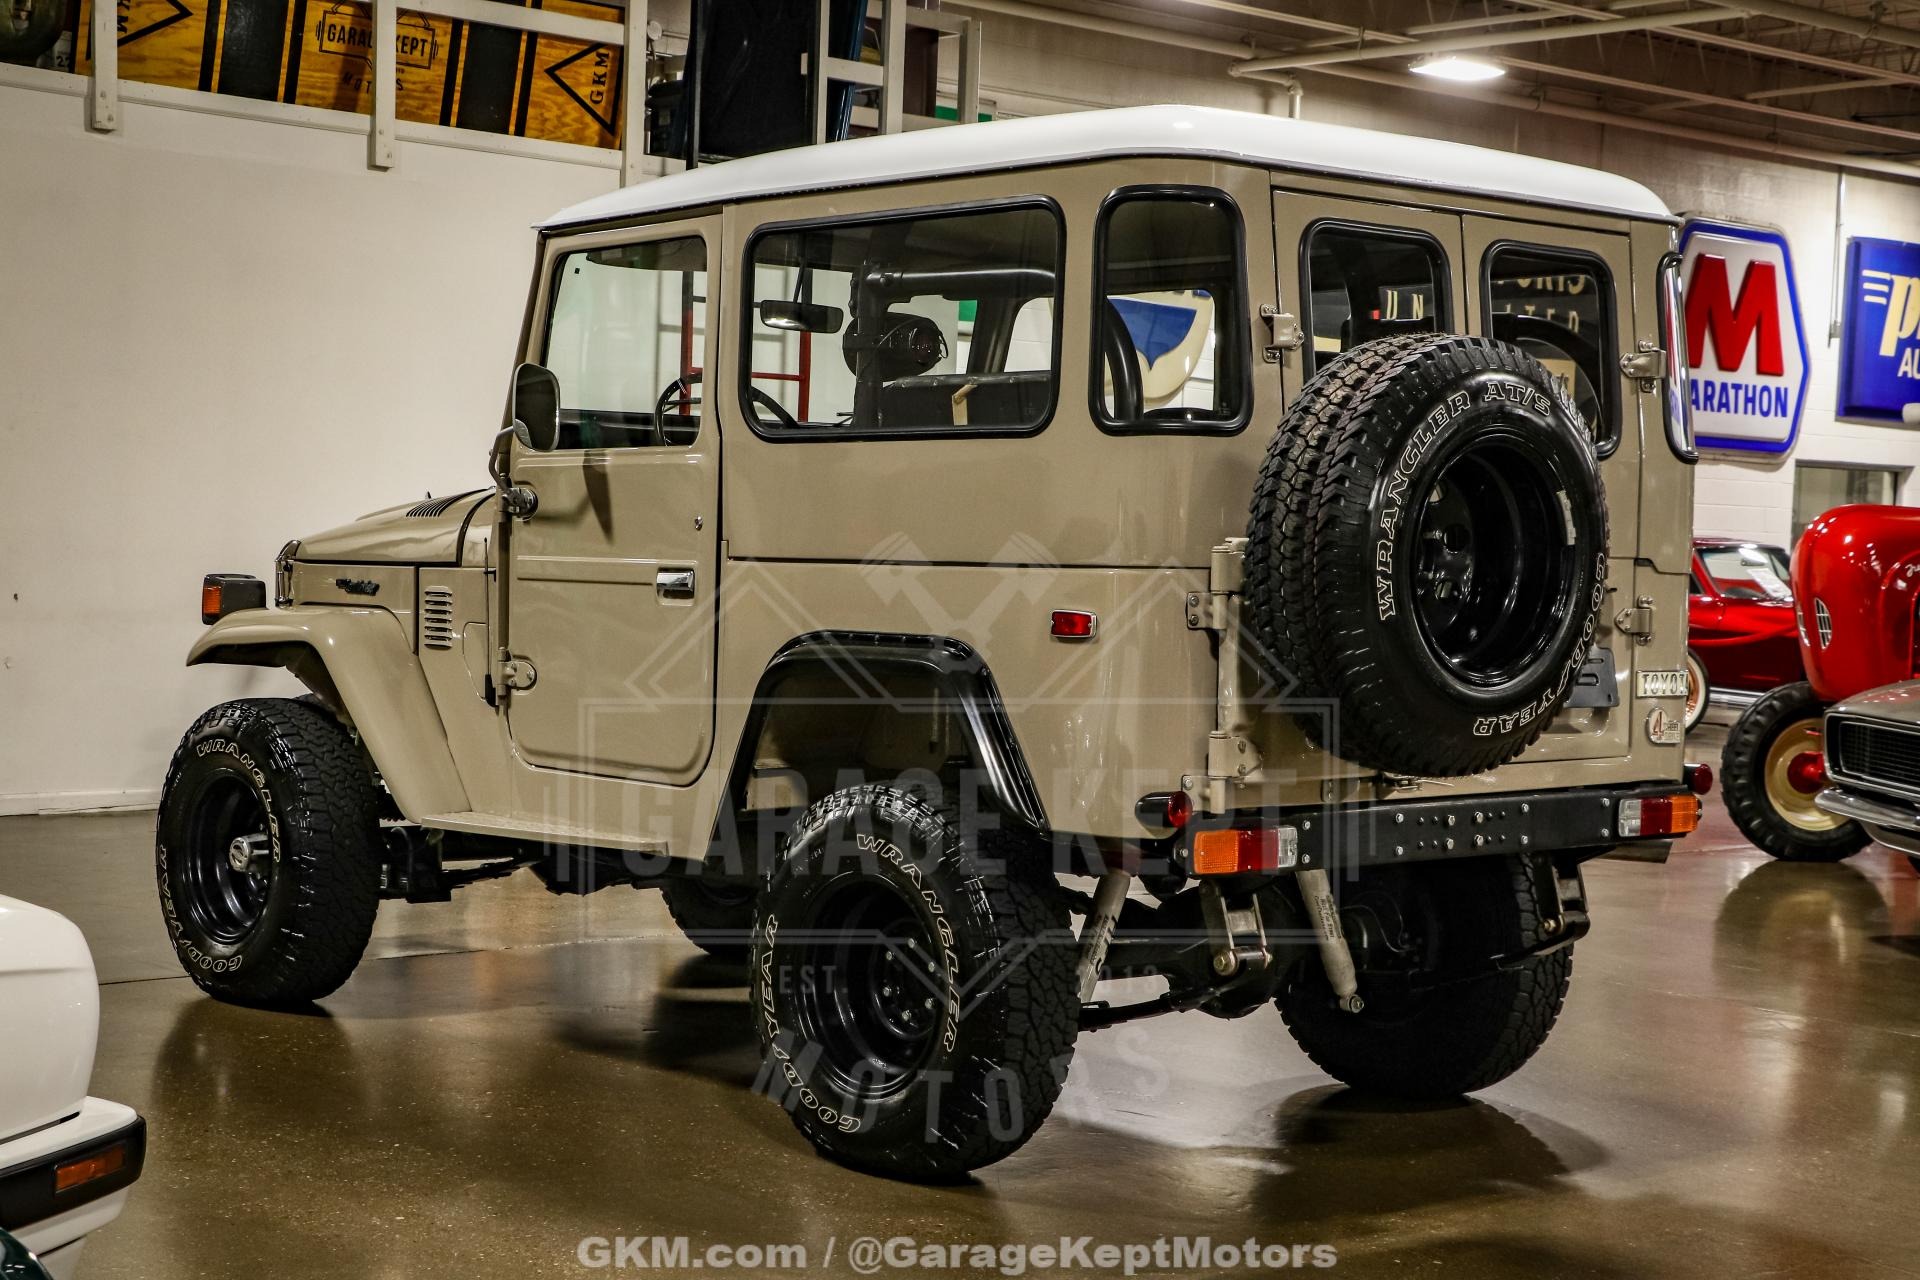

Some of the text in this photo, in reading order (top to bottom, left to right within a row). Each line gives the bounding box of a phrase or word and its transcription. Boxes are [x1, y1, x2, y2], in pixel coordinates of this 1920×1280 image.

[589, 50, 609, 105] GKM
[1685, 253, 1784, 376] M
[1690, 378, 1788, 418] ARATHON
[1378, 390, 1470, 622] WRANGLER
[1484, 380, 1552, 418] AT/S
[196, 738, 281, 863] WRANGLER
[856, 833, 961, 1052] WRANGLER
[760, 913, 862, 1134] GOODYEAR
